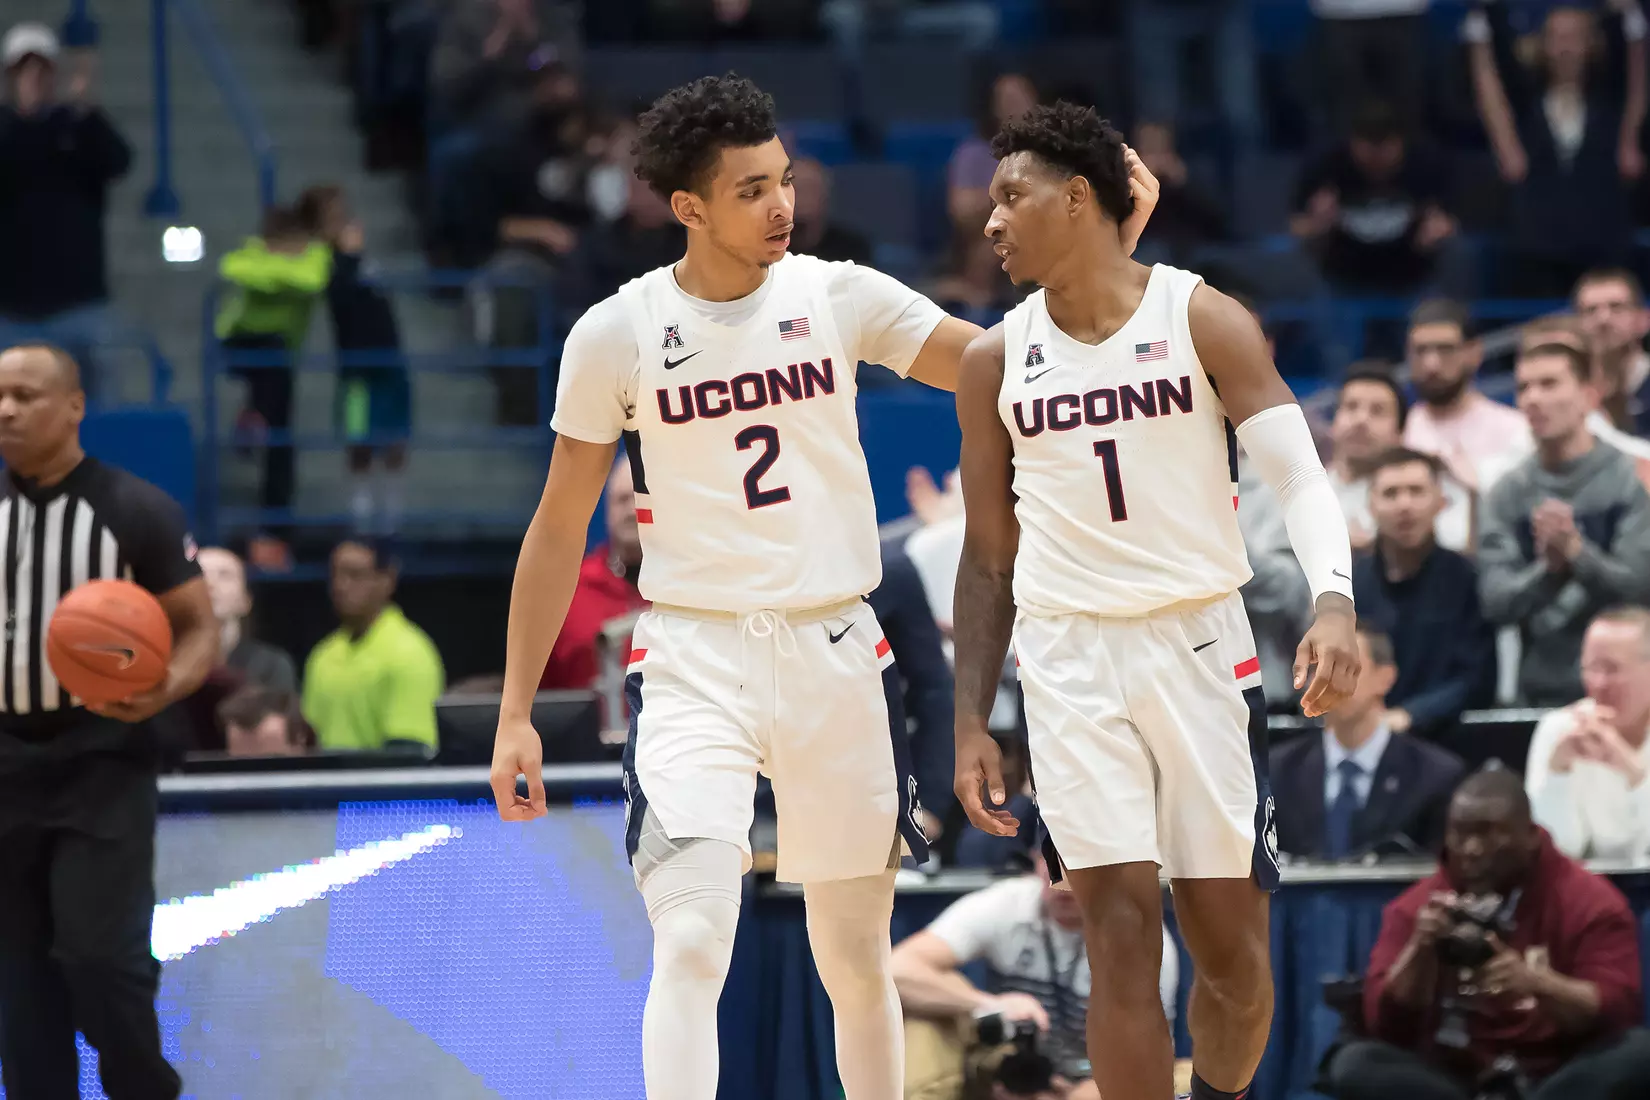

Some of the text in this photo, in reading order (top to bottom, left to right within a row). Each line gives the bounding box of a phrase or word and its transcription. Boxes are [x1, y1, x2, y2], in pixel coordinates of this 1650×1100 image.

[656, 358, 835, 424] UCONN
[1012, 375, 1193, 437] UCONN
[734, 425, 791, 510] 2
[1093, 439, 1128, 522] 1
